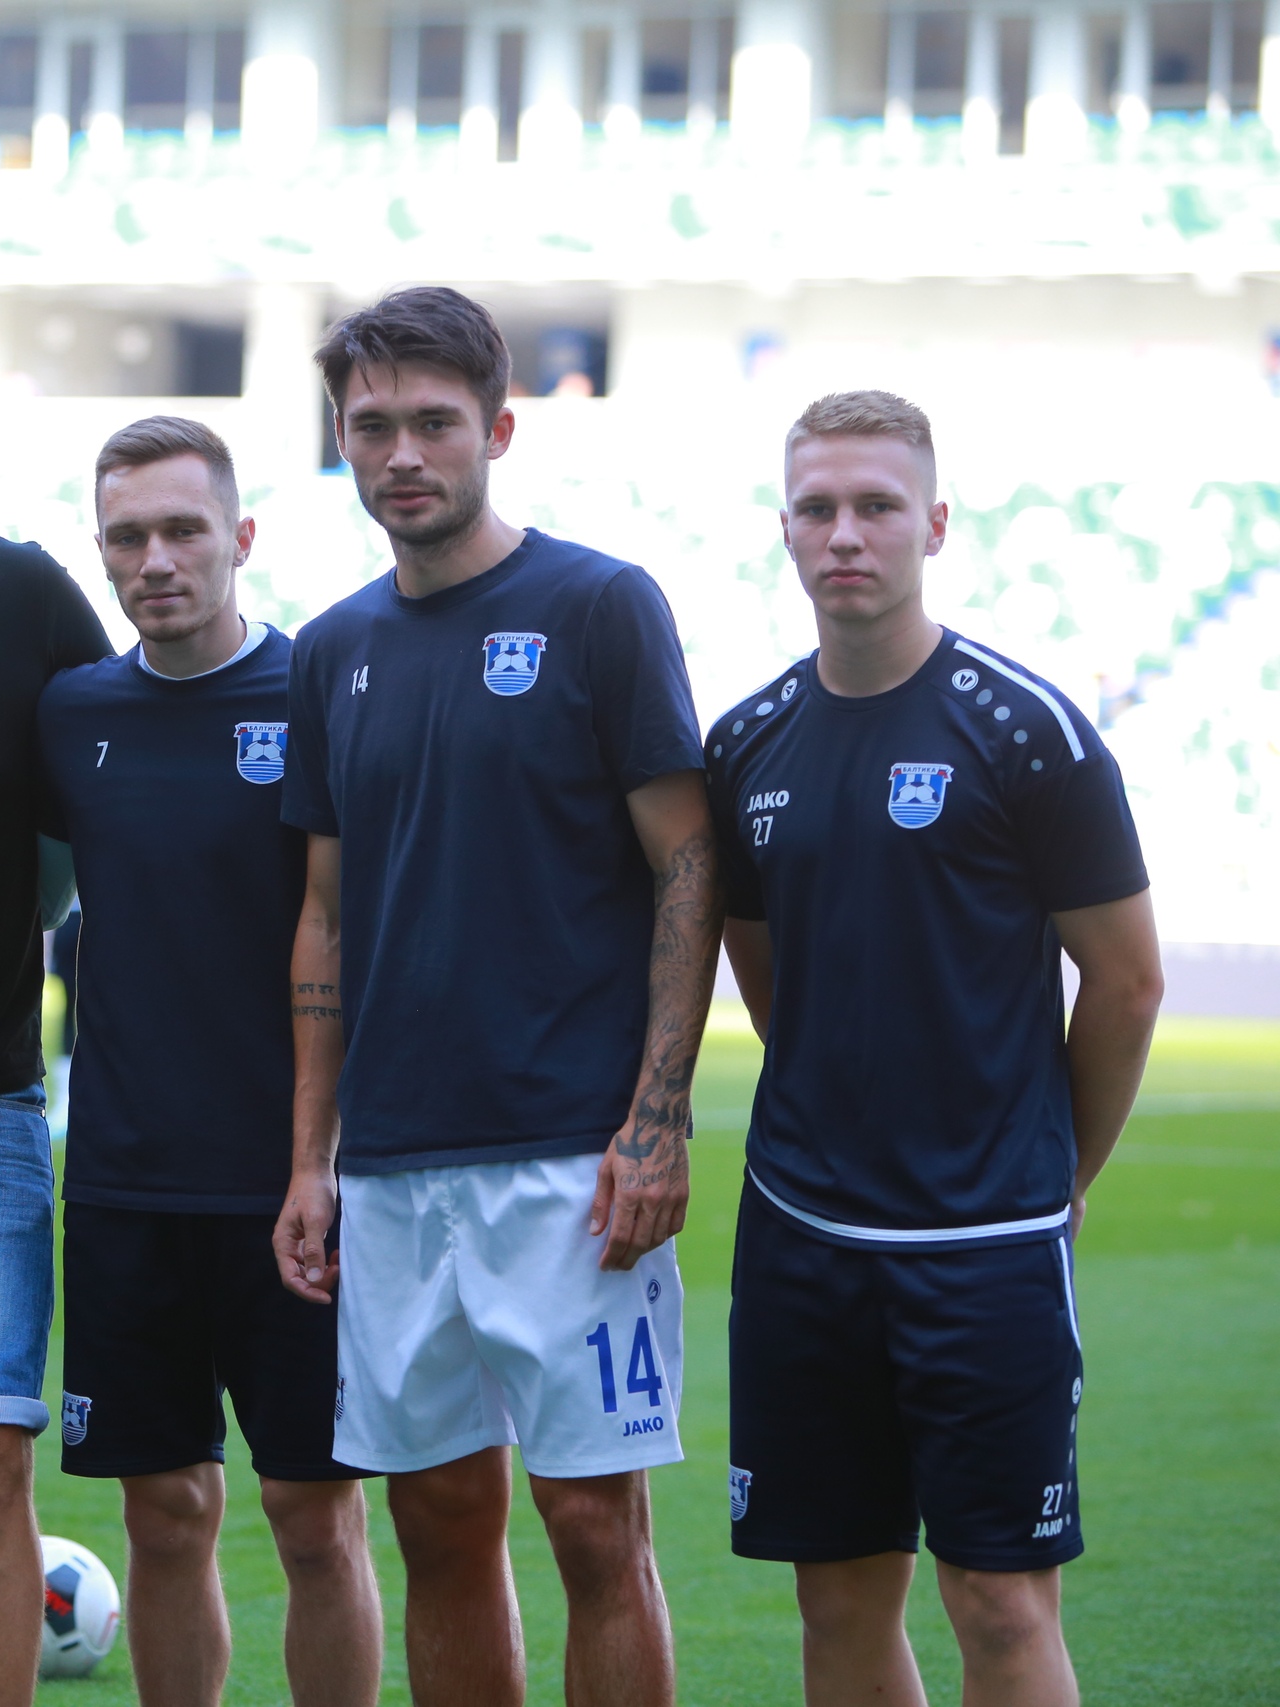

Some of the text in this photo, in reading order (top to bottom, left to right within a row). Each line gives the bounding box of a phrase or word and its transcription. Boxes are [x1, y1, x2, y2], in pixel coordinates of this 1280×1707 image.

[495, 635, 531, 643] БАЛТИКА
[351, 664, 369, 696] 14
[96, 740, 109, 768] 7
[902, 766, 937, 774] БАЛТИКА
[746, 790, 790, 813] JAKO
[752, 815, 774, 847] 27
[585, 1316, 663, 1414] 14
[622, 1416, 665, 1437] JAKO
[1041, 1483, 1064, 1516] 27
[1031, 1518, 1064, 1538] JAKO
